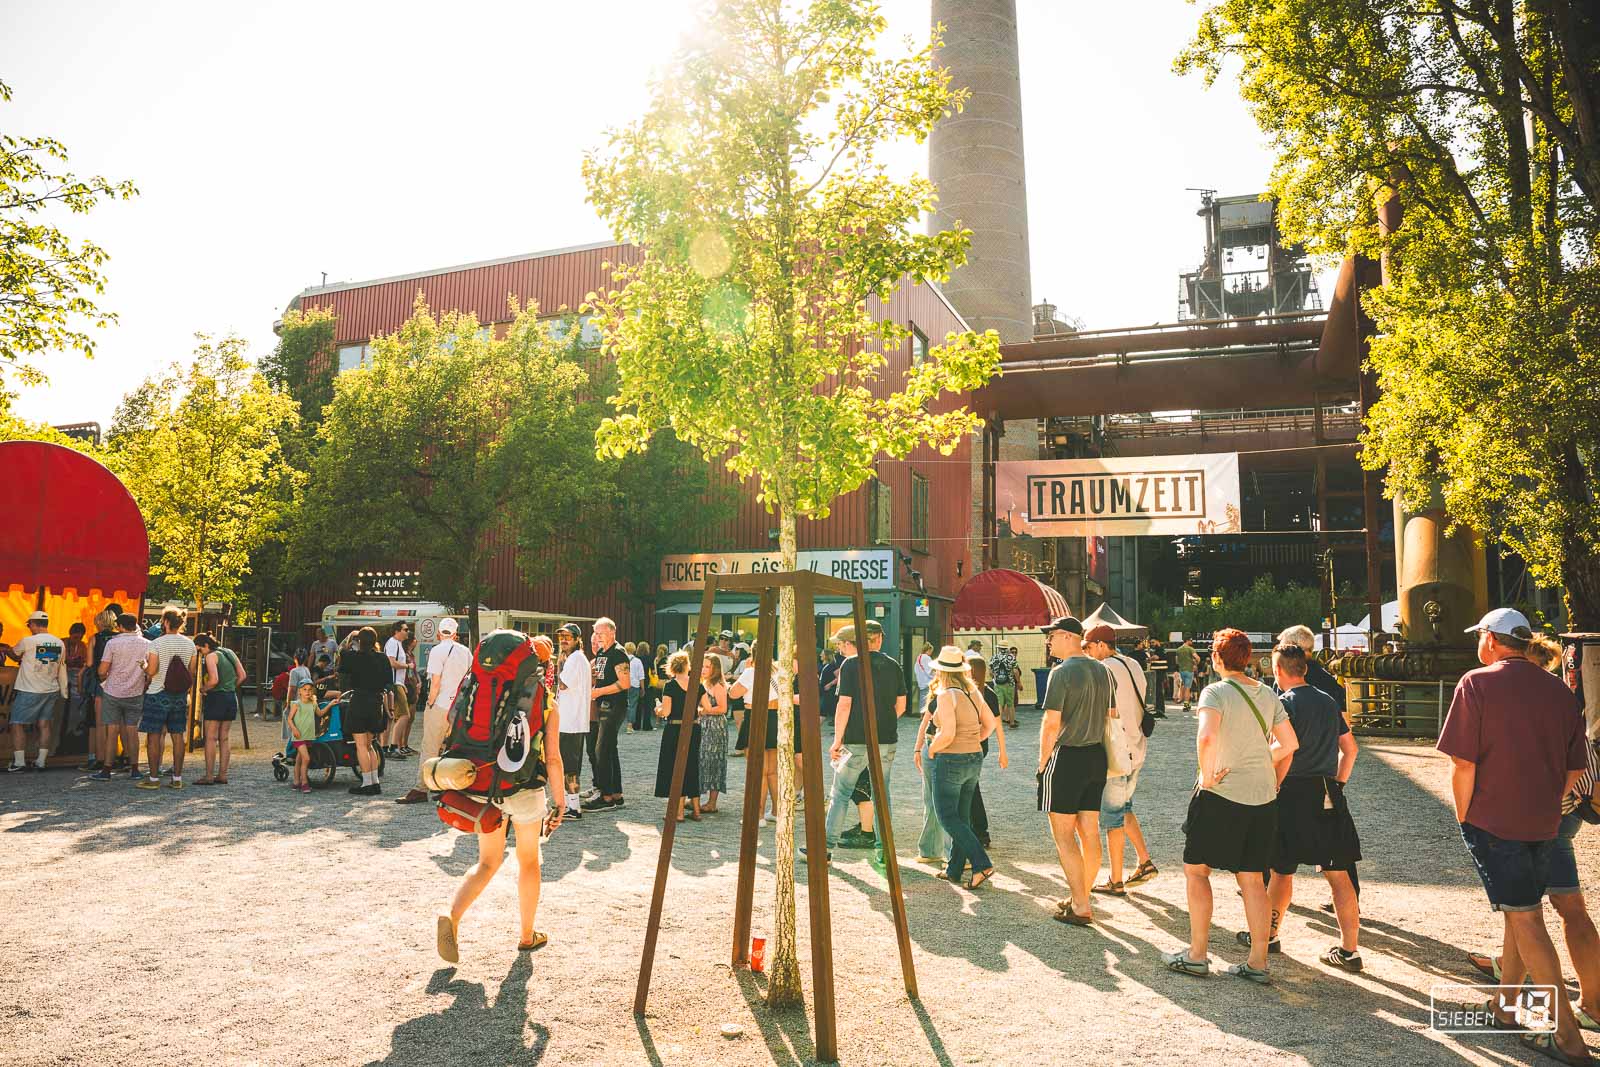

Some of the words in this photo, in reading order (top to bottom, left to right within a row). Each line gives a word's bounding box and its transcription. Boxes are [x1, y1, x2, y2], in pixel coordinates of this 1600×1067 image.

[1033, 476, 1199, 515] TRAUMZEIT
[665, 561, 718, 581] TICKETS
[831, 559, 889, 580] PRESSE
[372, 579, 377, 588] I
[377, 579, 387, 588] AM
[388, 578, 405, 588] LOVE
